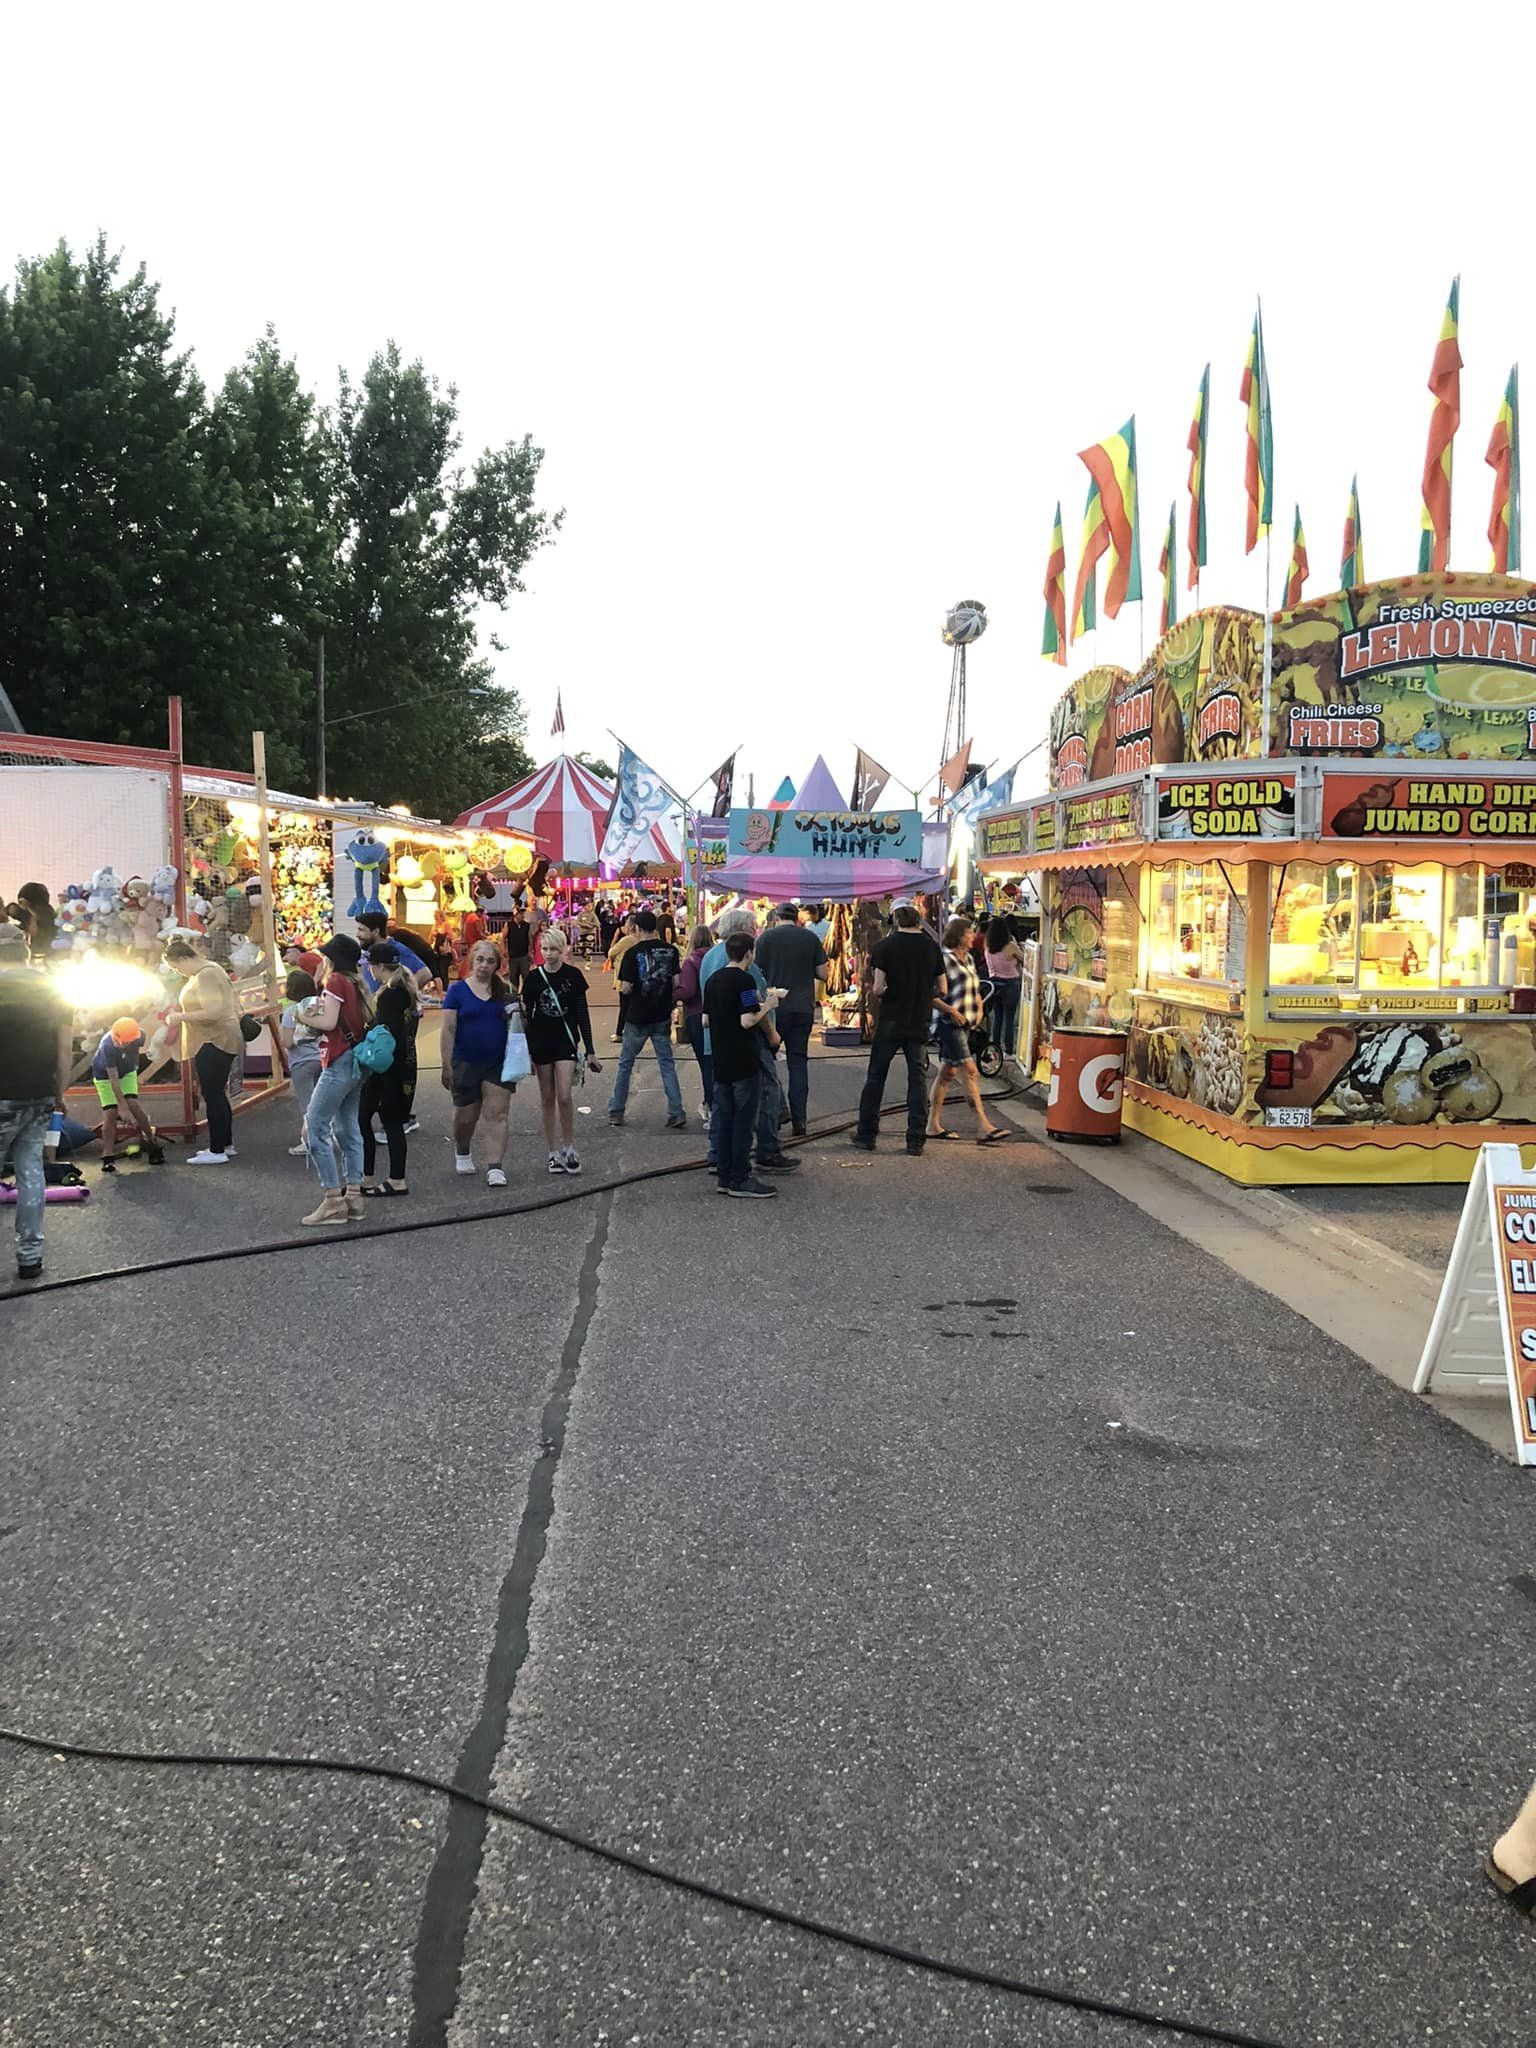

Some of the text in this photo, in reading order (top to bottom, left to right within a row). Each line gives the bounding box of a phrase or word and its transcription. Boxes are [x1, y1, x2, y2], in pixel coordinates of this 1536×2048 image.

[1379, 604, 1434, 622] Fresh
[1116, 688, 1152, 740] CORN
[1200, 694, 1240, 748] FRIES
[1290, 703, 1382, 719] Chili Cheese
[1290, 718, 1379, 747] FRIES
[1170, 781, 1283, 808] ICE COLD
[1409, 783, 1485, 804] HAND
[795, 812, 901, 835] OCTOPUS
[1193, 810, 1258, 834] SODA
[1364, 809, 1460, 833] JUMBO
[813, 832, 886, 858] HUNT
[1382, 997, 1416, 1009] STICKS
[1423, 998, 1458, 1009] CHICKE
